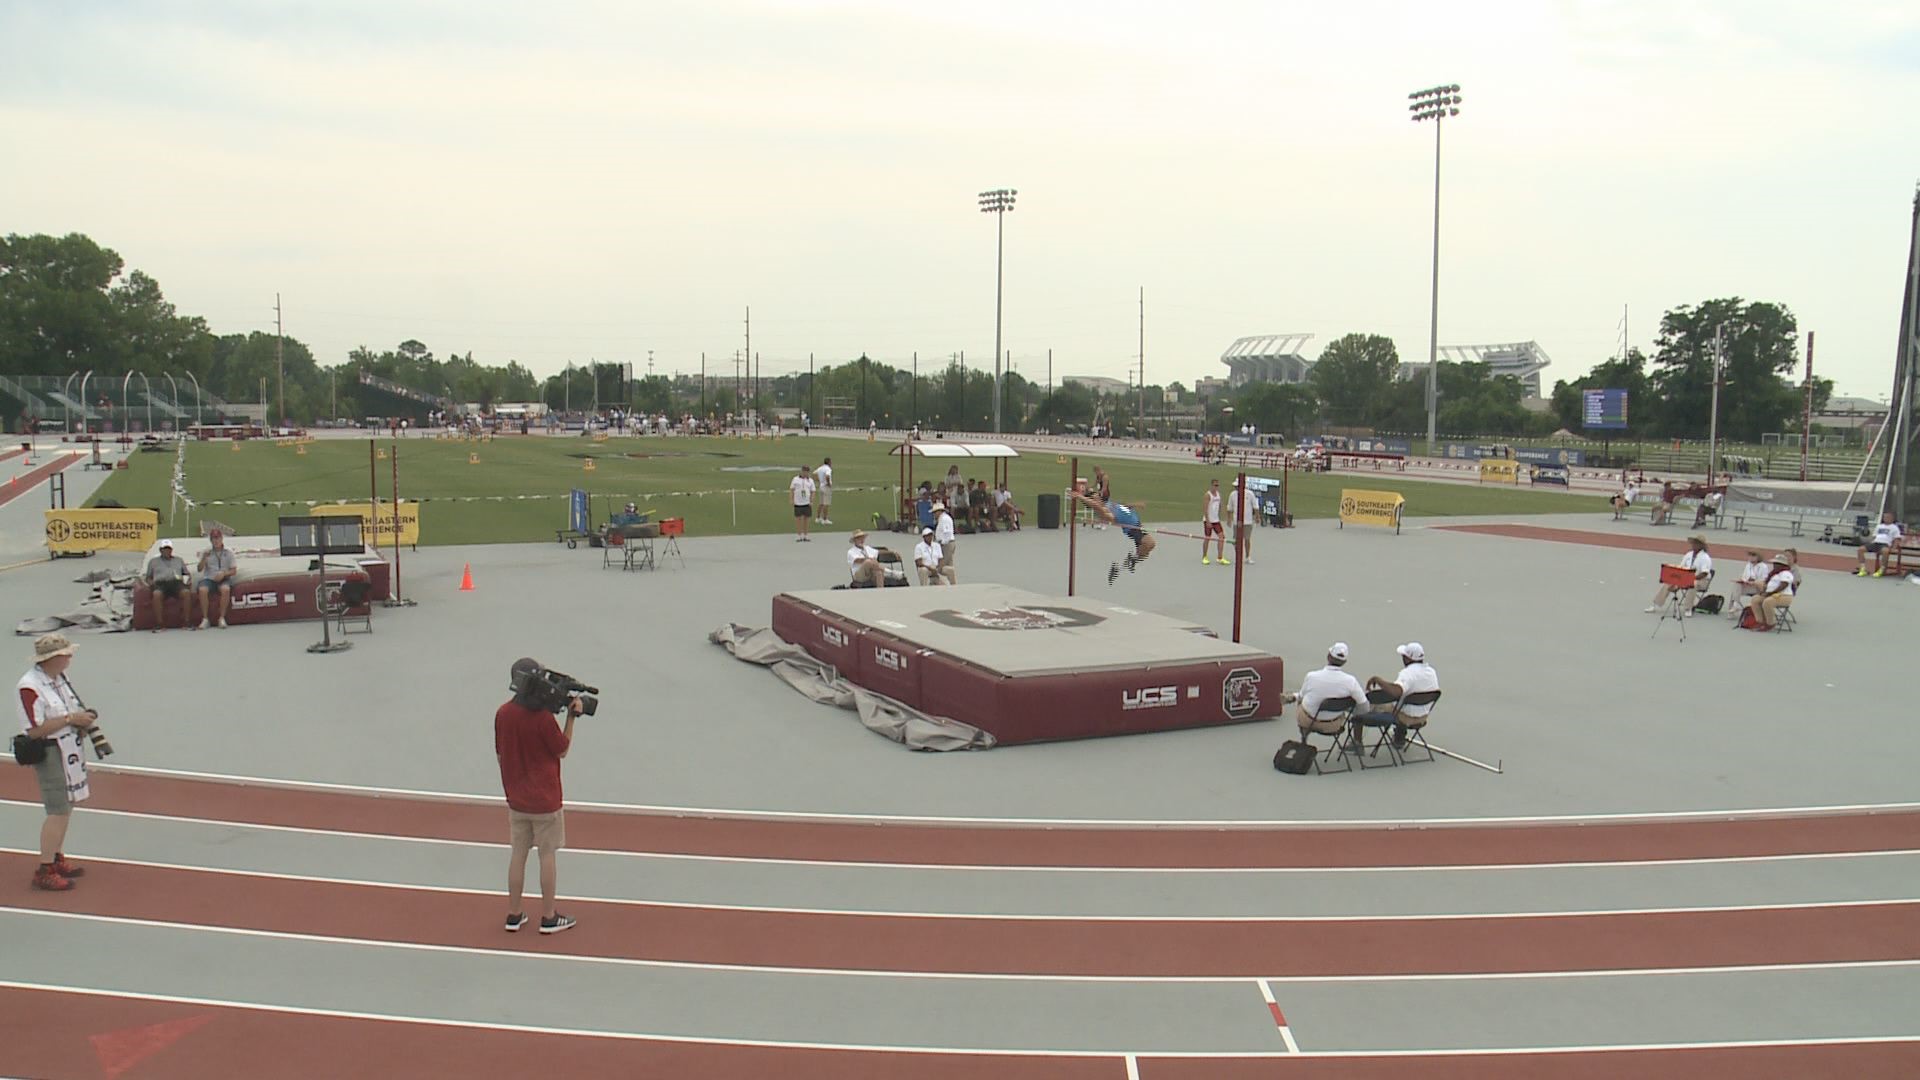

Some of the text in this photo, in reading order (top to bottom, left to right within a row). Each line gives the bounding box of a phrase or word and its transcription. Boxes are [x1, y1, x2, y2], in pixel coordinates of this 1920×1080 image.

[1356, 508, 1393, 517] CONFERENC
[73, 522, 154, 530] SOUTHEASTERN
[73, 531, 141, 539] CONFERENCE
[231, 591, 278, 606] UCS
[822, 623, 842, 642] UCS
[874, 645, 898, 666] UCS
[1122, 685, 1177, 704] UCS
